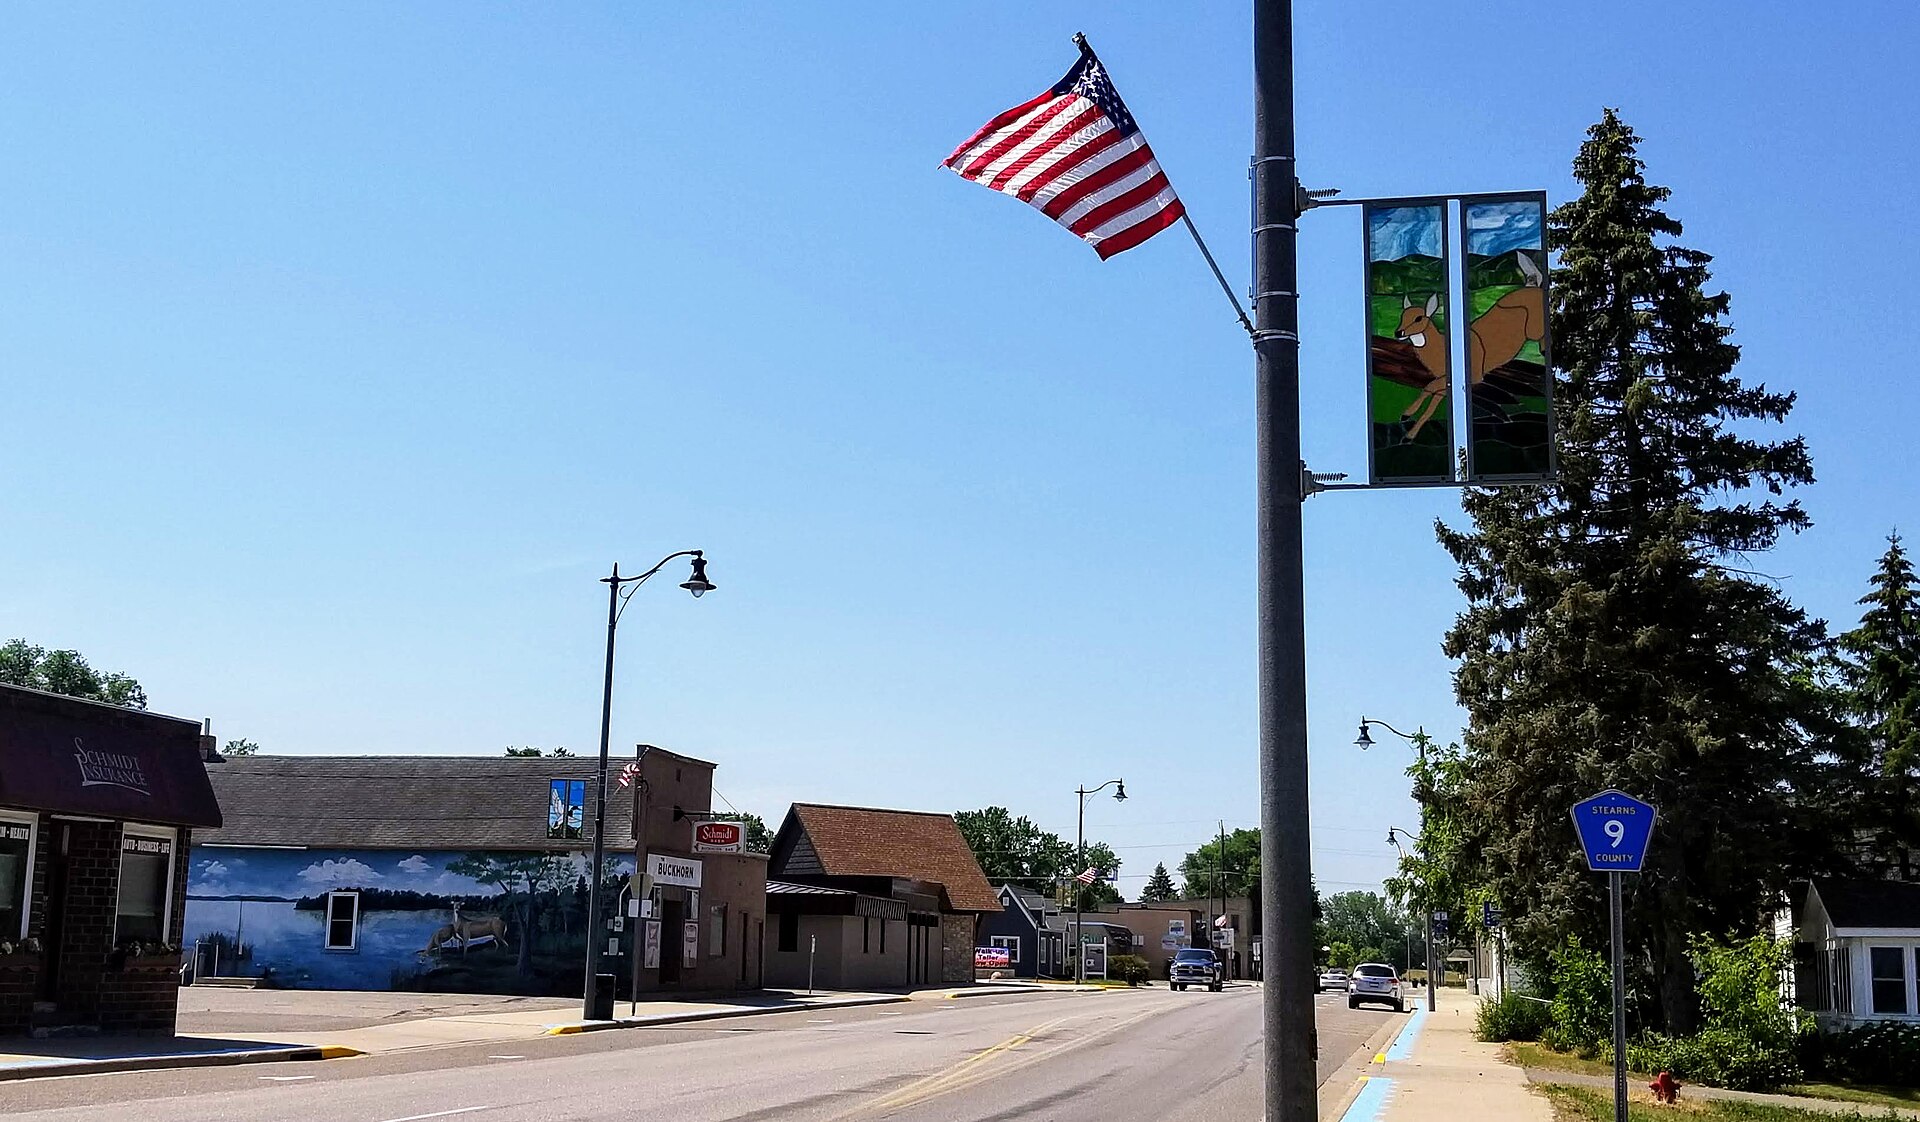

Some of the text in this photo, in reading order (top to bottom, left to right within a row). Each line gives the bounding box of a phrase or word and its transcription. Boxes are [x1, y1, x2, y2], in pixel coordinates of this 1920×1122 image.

[75, 736, 141, 771] SCHMIDT
[74, 753, 148, 787] INSURANCE
[1592, 806, 1636, 815] STEARNS
[10, 827, 29, 840] HEALTH
[702, 826, 732, 839] Schmidt
[1604, 820, 1624, 848] 9
[1595, 854, 1634, 862] COUNTY
[658, 862, 694, 879] BUCKHORN
